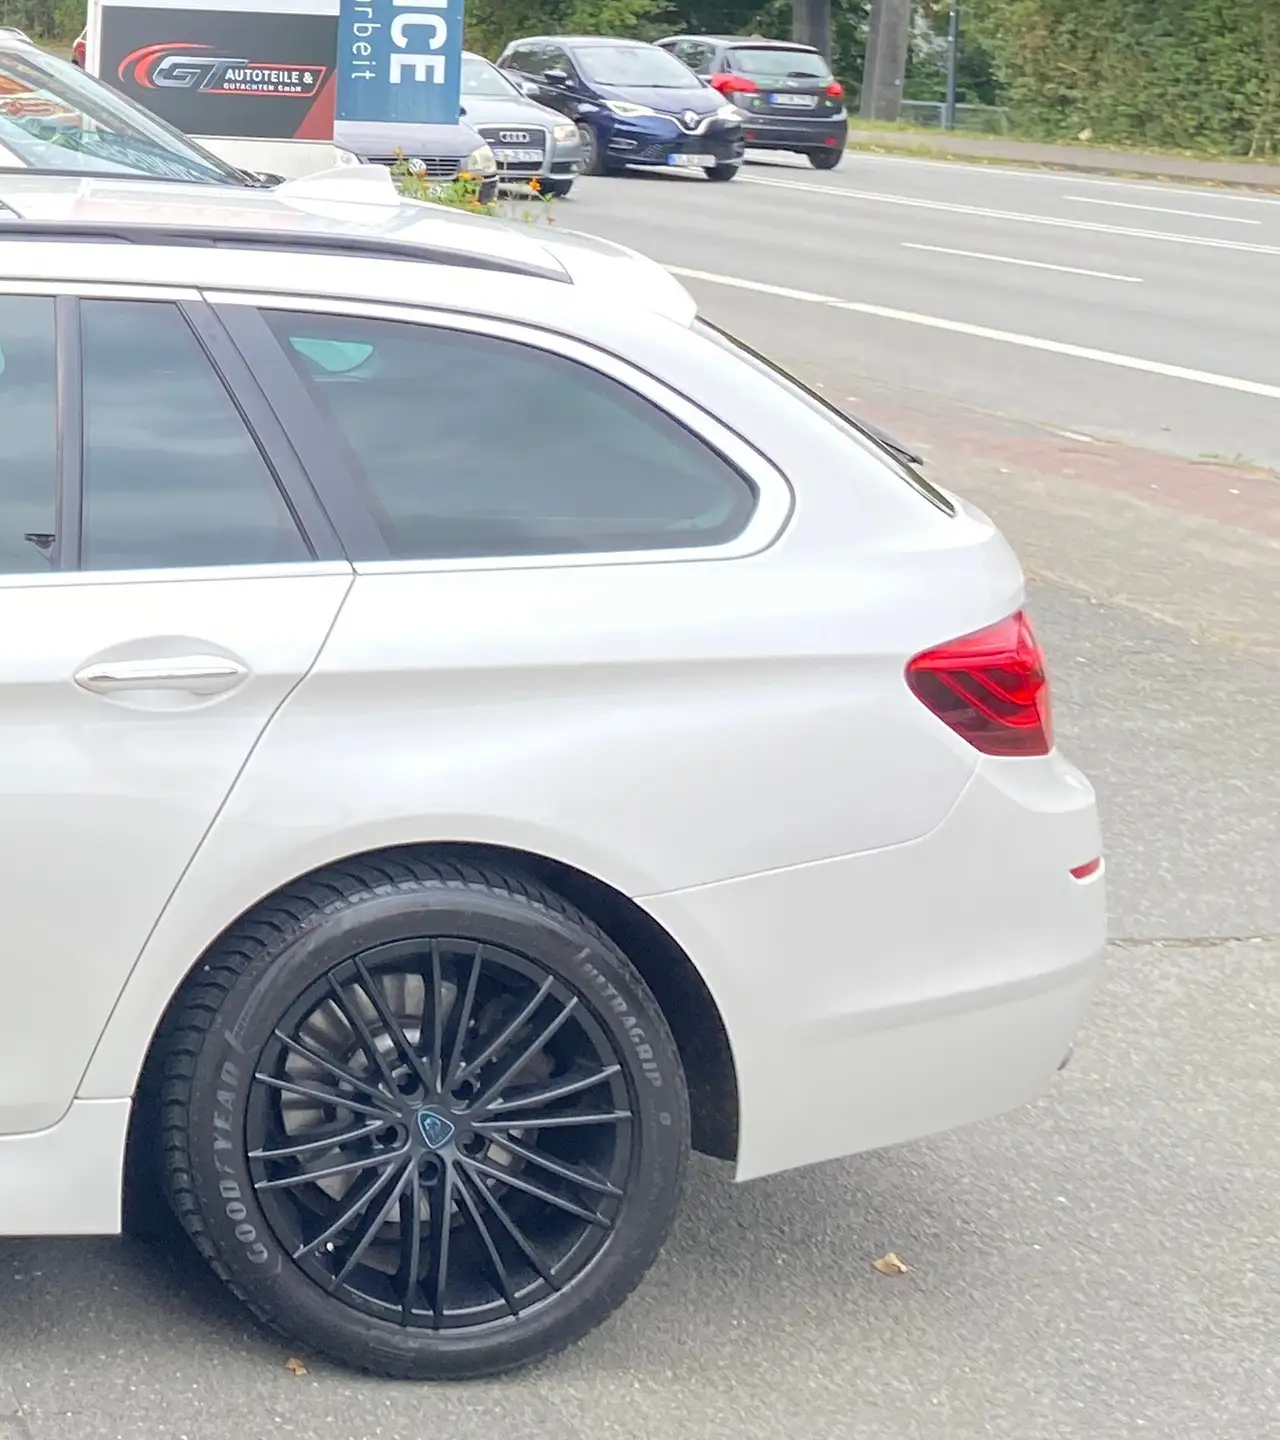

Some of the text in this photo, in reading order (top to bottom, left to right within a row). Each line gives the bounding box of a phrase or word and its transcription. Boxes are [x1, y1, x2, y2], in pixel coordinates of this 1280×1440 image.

[225, 69, 314, 84] AUTOTEILE &
[223, 83, 275, 92] GUTACHTEN
[213, 1061, 268, 1264] GOODYEAR
